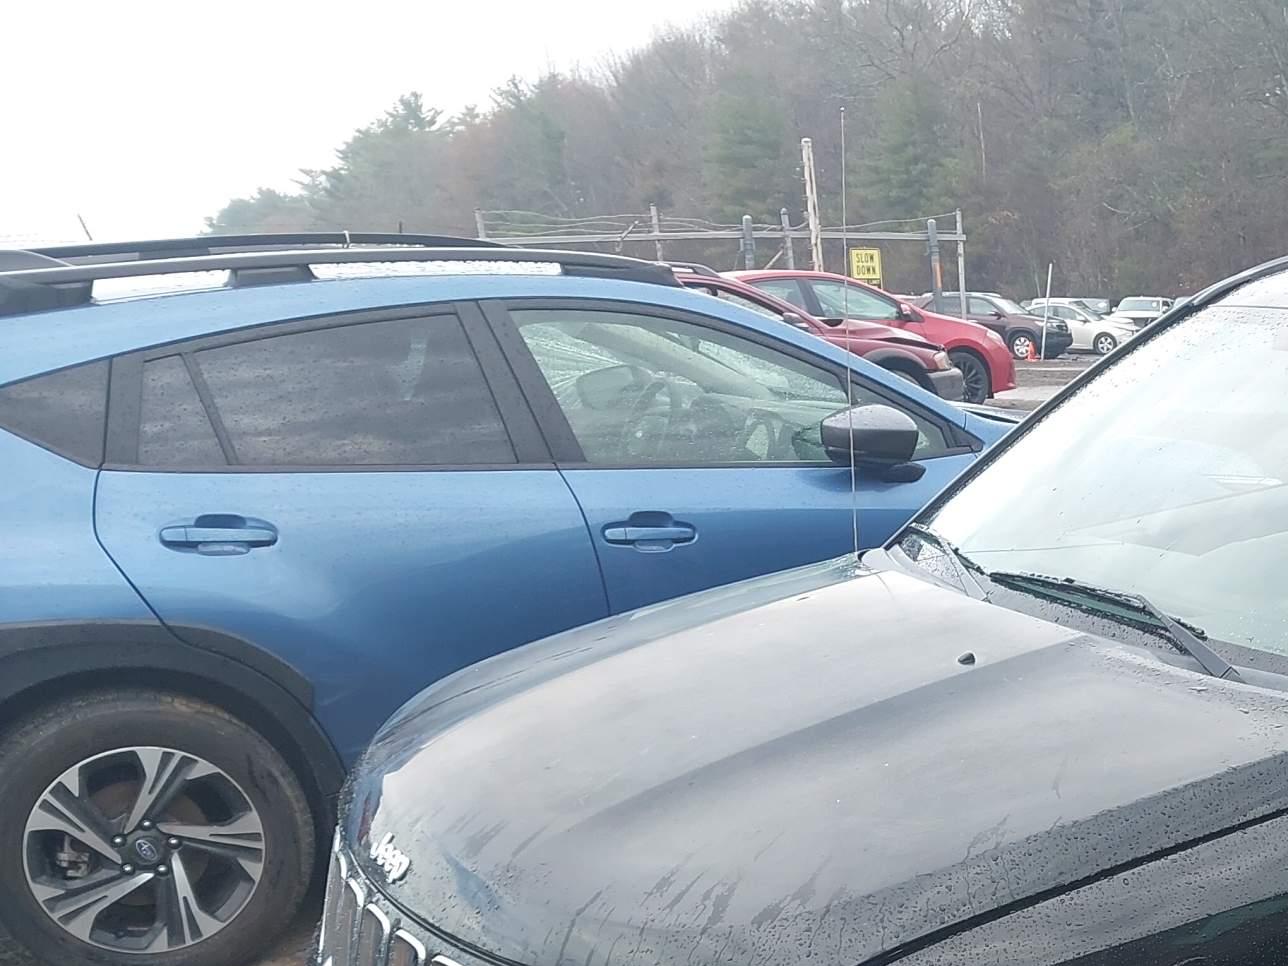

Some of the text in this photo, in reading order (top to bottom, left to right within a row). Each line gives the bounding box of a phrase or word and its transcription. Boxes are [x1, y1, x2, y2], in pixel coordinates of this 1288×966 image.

[855, 252, 874, 263] SLOW
[856, 265, 877, 276] DOWN
[370, 832, 411, 884] Jeep
